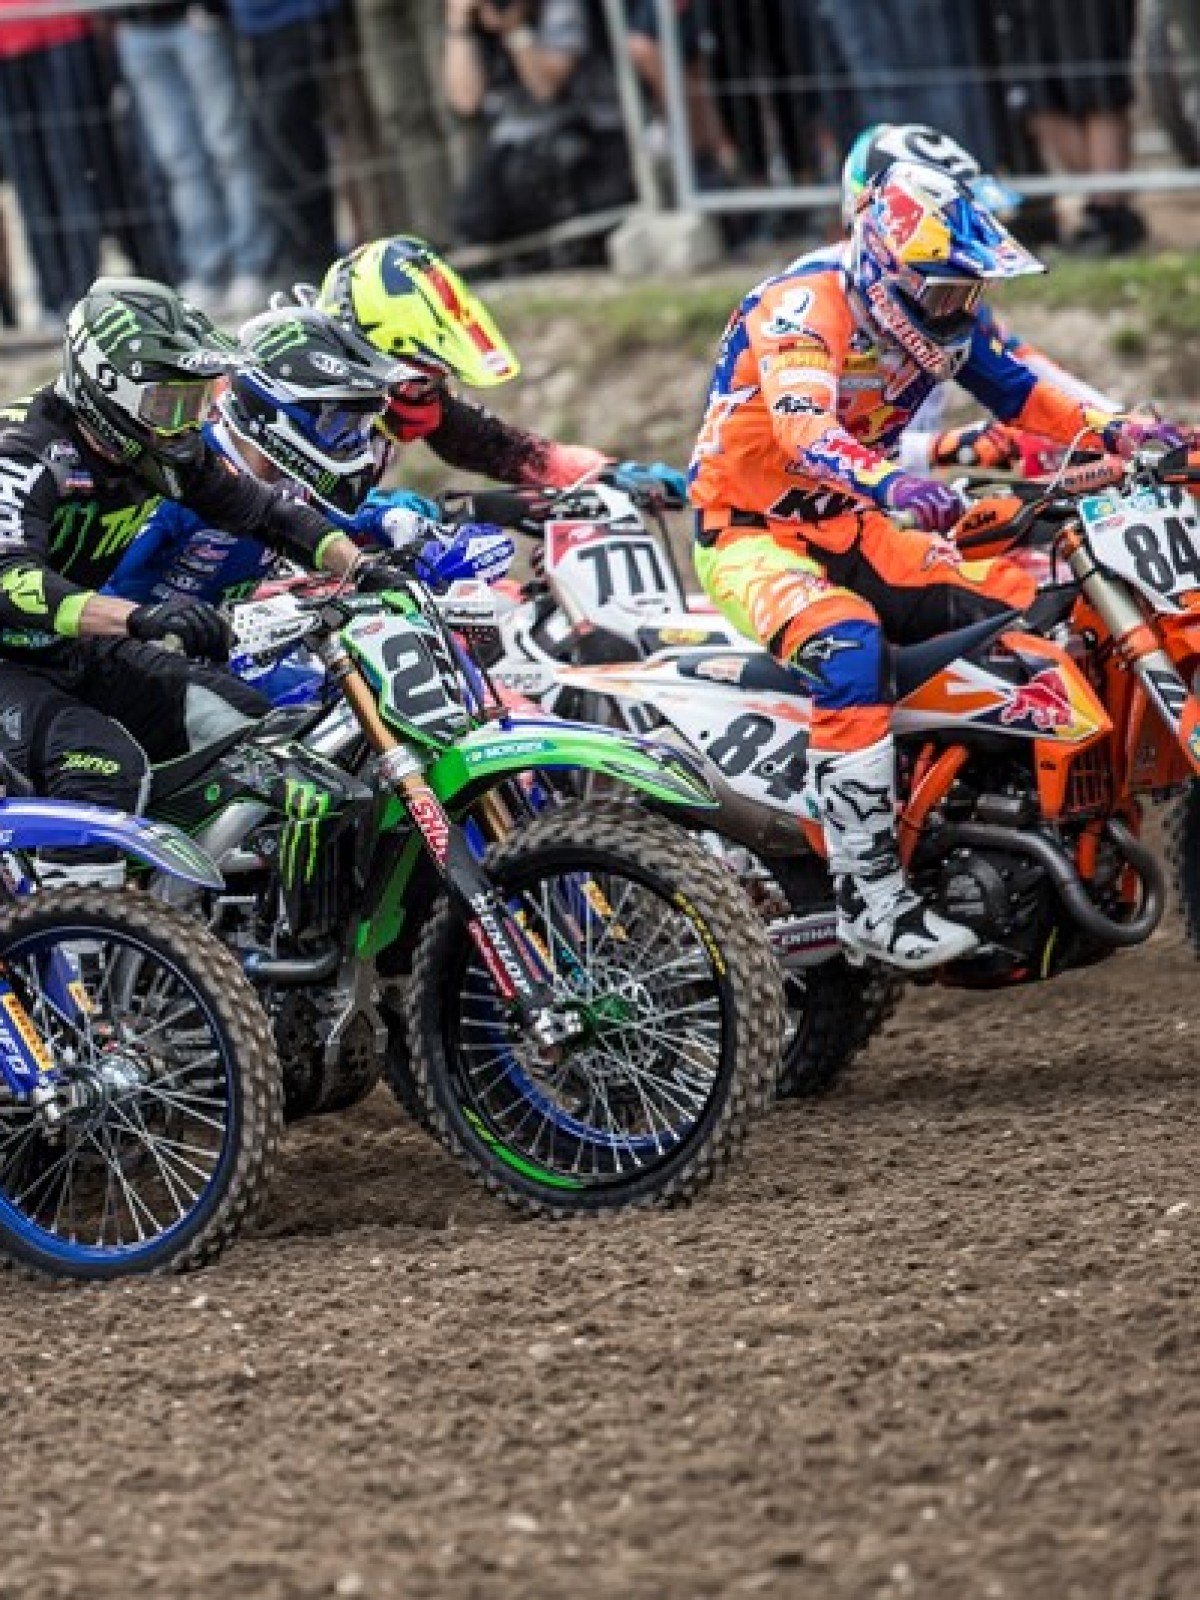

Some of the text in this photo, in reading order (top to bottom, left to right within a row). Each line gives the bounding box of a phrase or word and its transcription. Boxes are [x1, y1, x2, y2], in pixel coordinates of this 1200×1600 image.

[576, 541, 668, 607] 777
[1122, 515, 1200, 595] 84
[705, 712, 812, 802] 84
